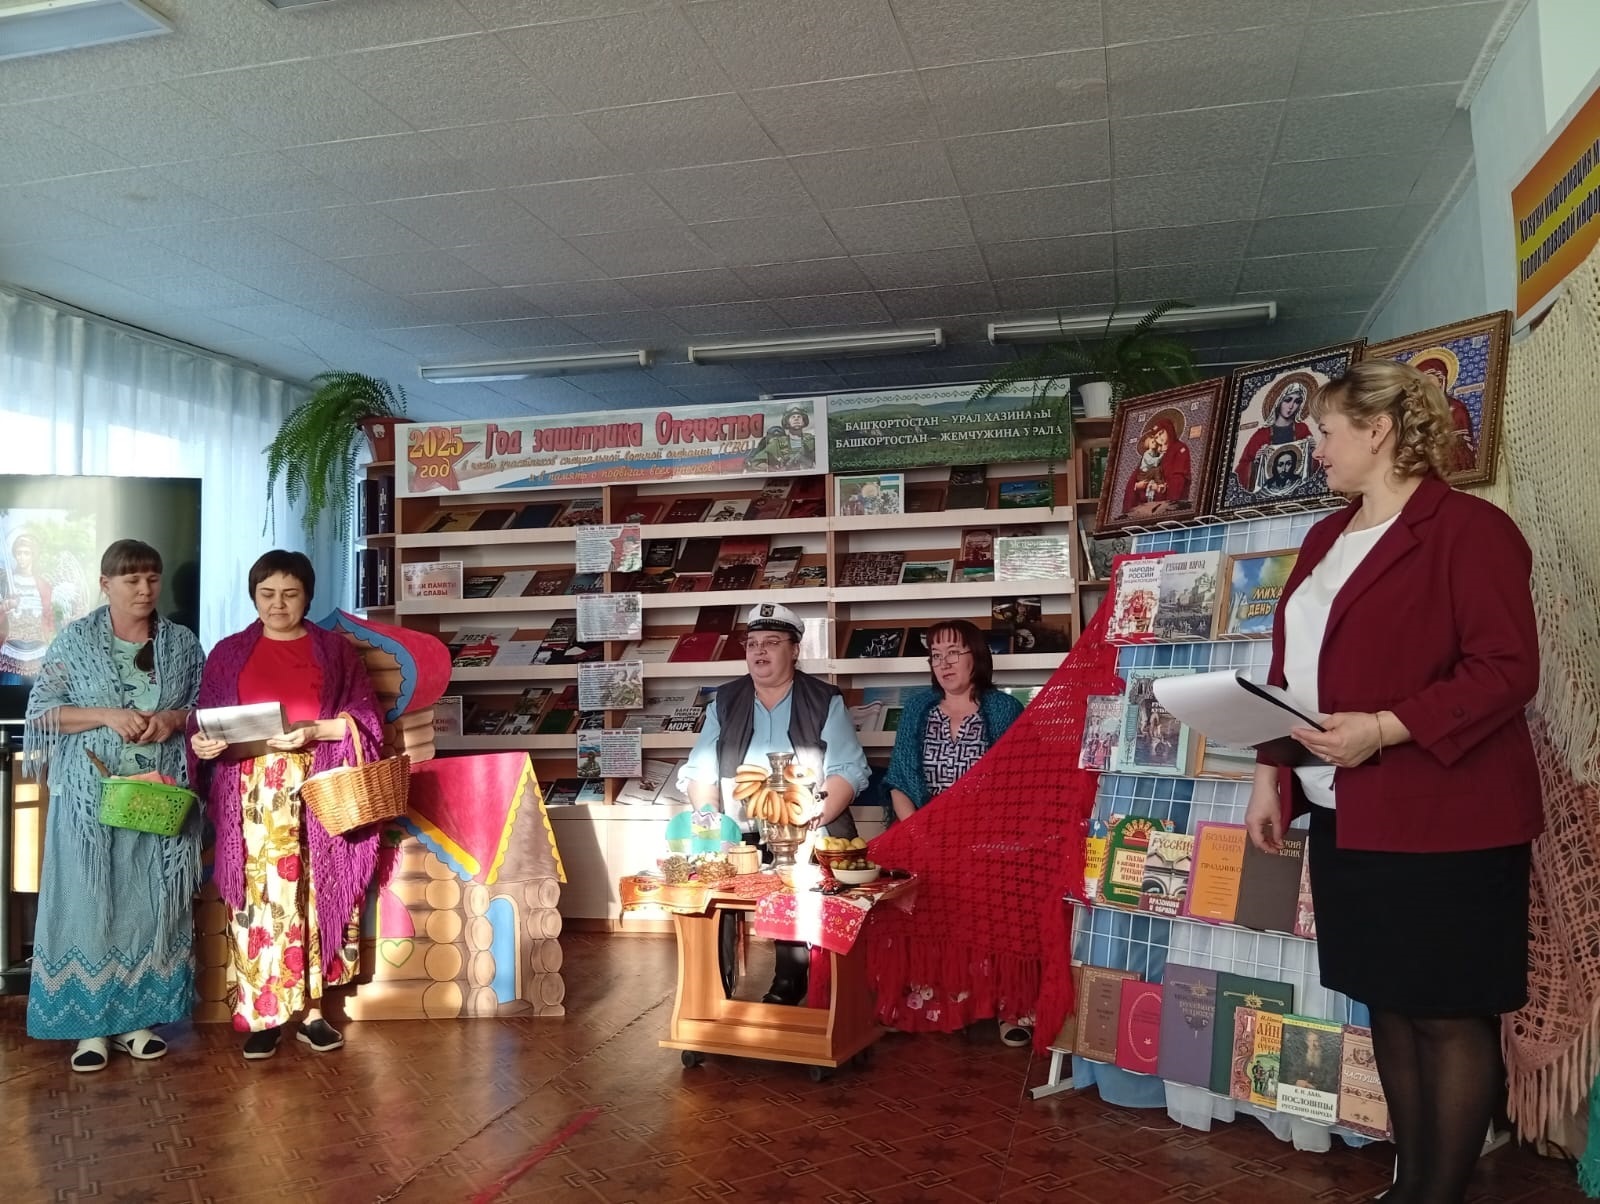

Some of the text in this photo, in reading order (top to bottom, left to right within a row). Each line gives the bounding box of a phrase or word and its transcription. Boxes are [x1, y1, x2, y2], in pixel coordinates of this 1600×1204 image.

[1545, 147, 1592, 218] информация
[1519, 184, 1600, 284] Уголок правовой инфо
[951, 413, 981, 425] УРАЛ
[409, 426, 464, 458] 2025
[485, 423, 523, 460] Год
[655, 411, 765, 446] Отечества
[835, 433, 929, 449] БАШКОРТОСТАН
[940, 427, 1021, 442] ЖЕМЧУЖИНА
[420, 457, 451, 479] год
[548, 470, 589, 481] память
[600, 465, 645, 480] подвигах
[423, 589, 448, 597] СЛАВЫ
[1247, 602, 1272, 618] ДЕНЬ
[667, 721, 696, 731] МОРЕ
[1281, 1094, 1334, 1111] ПОСЛОВИЦЫ
